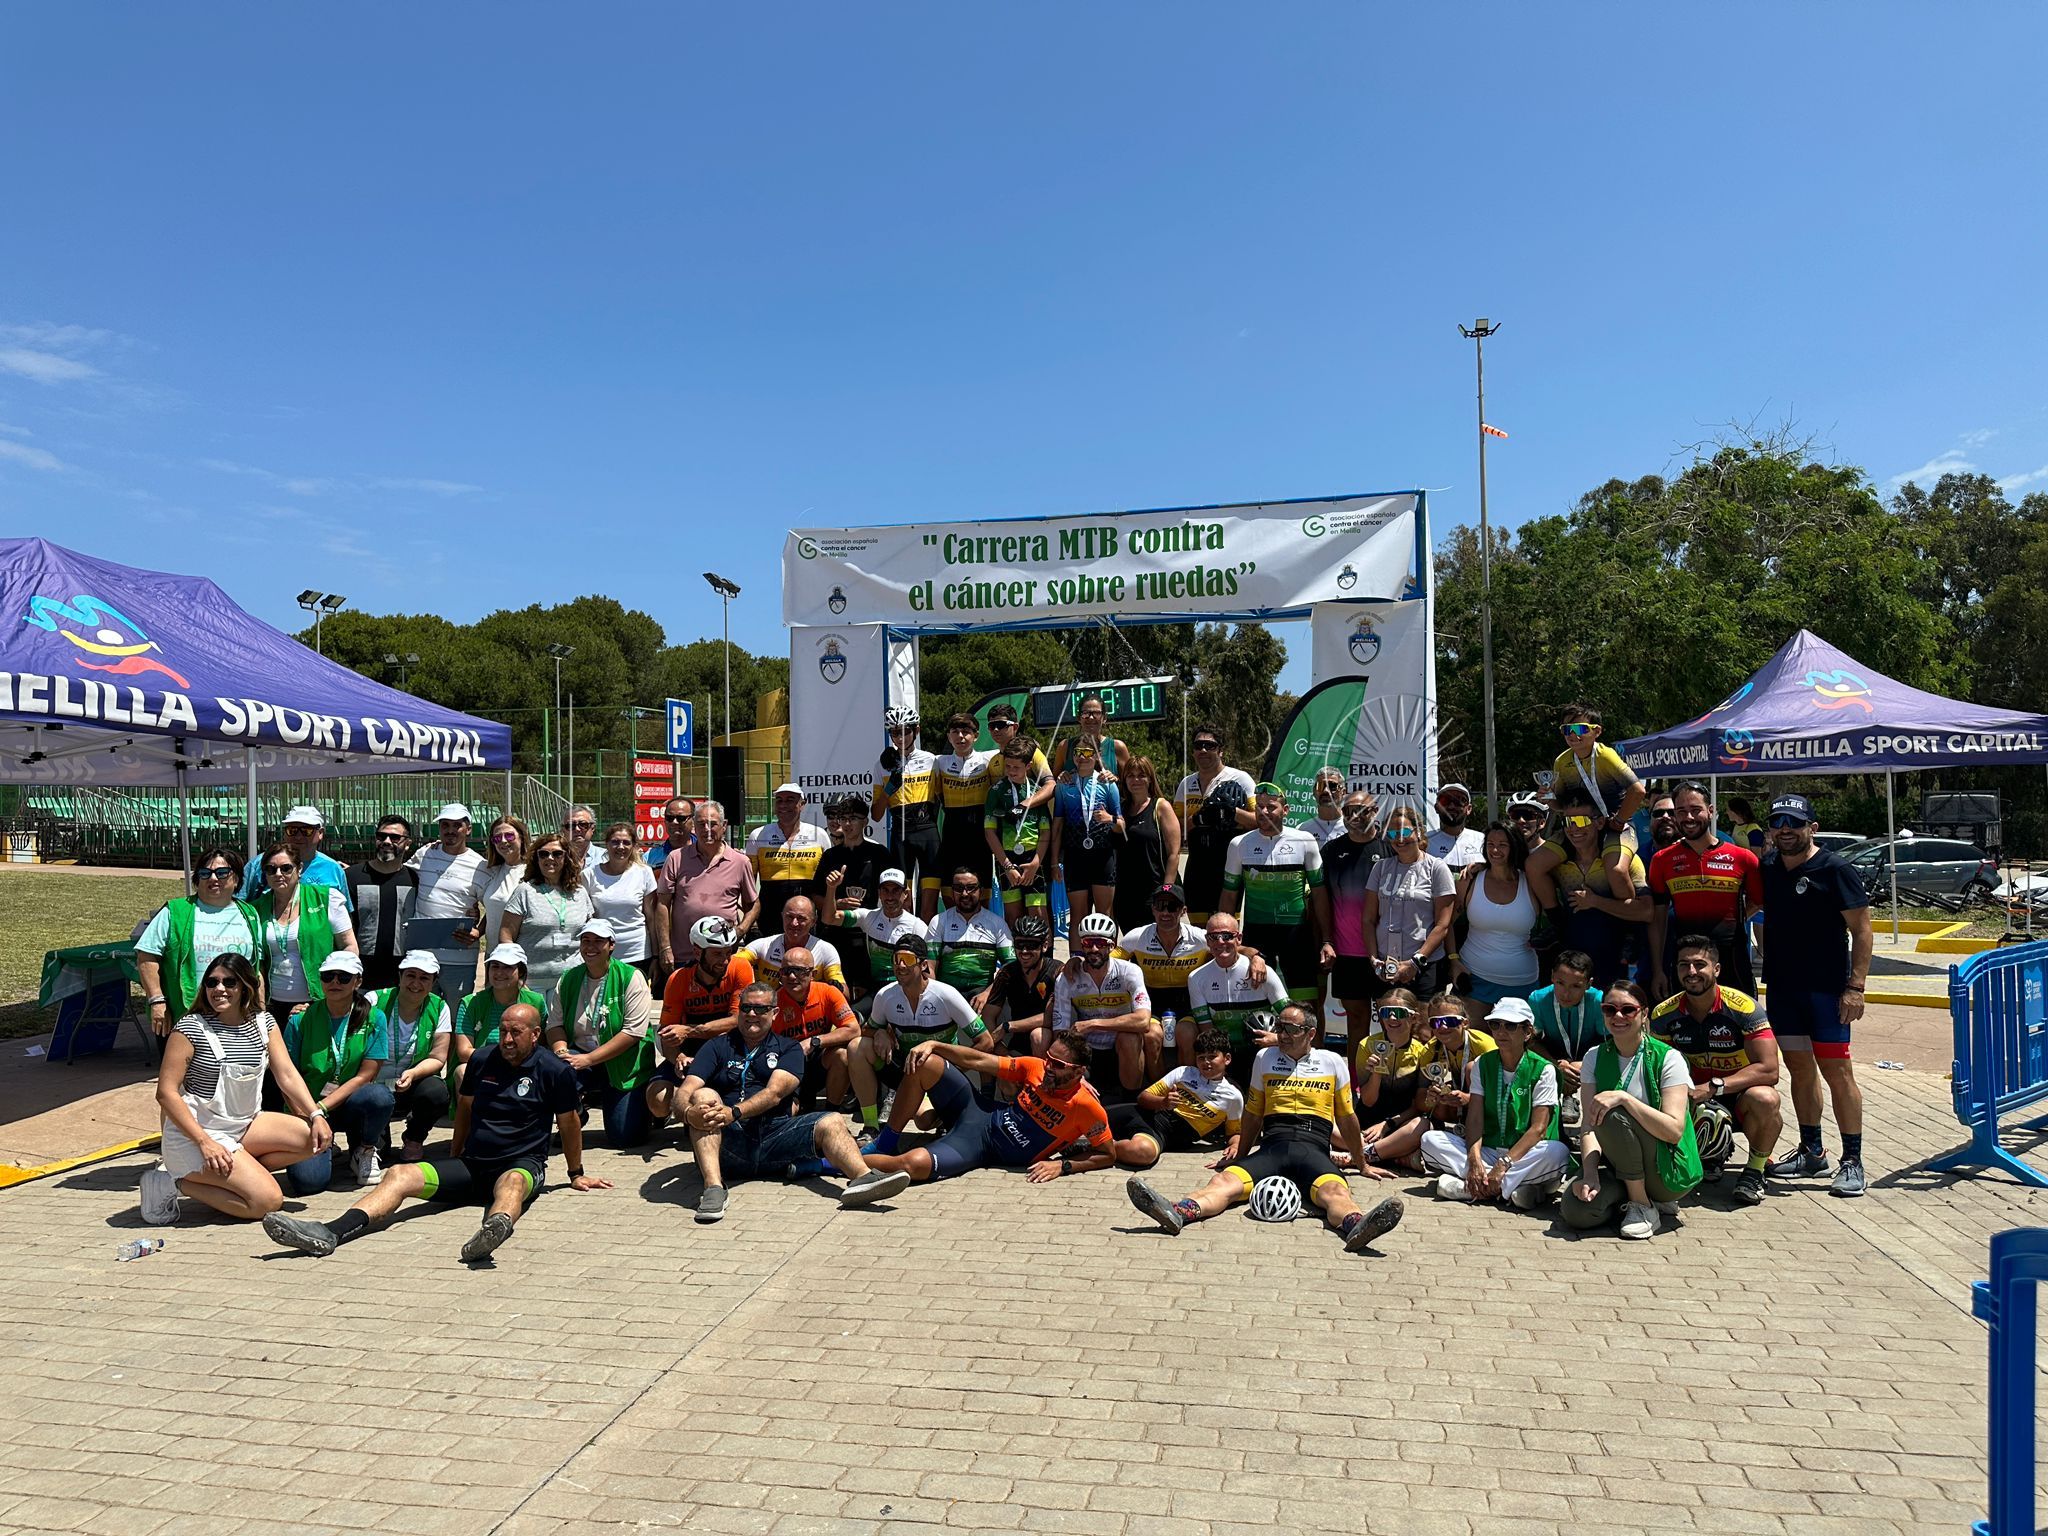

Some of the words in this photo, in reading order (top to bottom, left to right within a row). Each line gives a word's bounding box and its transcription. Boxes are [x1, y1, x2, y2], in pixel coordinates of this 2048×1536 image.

[1059, 527, 1118, 560] MTB
[1128, 521, 1224, 555] contra
[908, 581, 934, 611] el
[943, 577, 1037, 609] cáncer
[1047, 574, 1125, 605] sobre
[215, 697, 351, 750] SPORT
[361, 718, 485, 766] CAPITAL
[673, 706, 687, 748] P
[1761, 738, 1853, 760] MELILLA
[1863, 735, 1940, 755] SPORT
[1946, 733, 2043, 753] CAPITAL
[1626, 752, 1654, 769] MELILLA
[1656, 748, 1679, 766] SPORT
[1680, 744, 1708, 764] CAPITAL
[1349, 761, 1417, 776] ERACIÓN
[799, 770, 873, 787] FEDERACIÓ
[1288, 773, 1314, 786] Tene
[1285, 789, 1299, 798] un
[1301, 791, 1315, 802] gr
[1772, 801, 1803, 810] MILLER
[765, 851, 796, 859] RUTEROS
[1143, 959, 1175, 967] RUTEROS
[1176, 957, 1199, 966] BIKES
[1267, 1079, 1303, 1088] RUTEROS
[1304, 1080, 1331, 1091] BIKES
